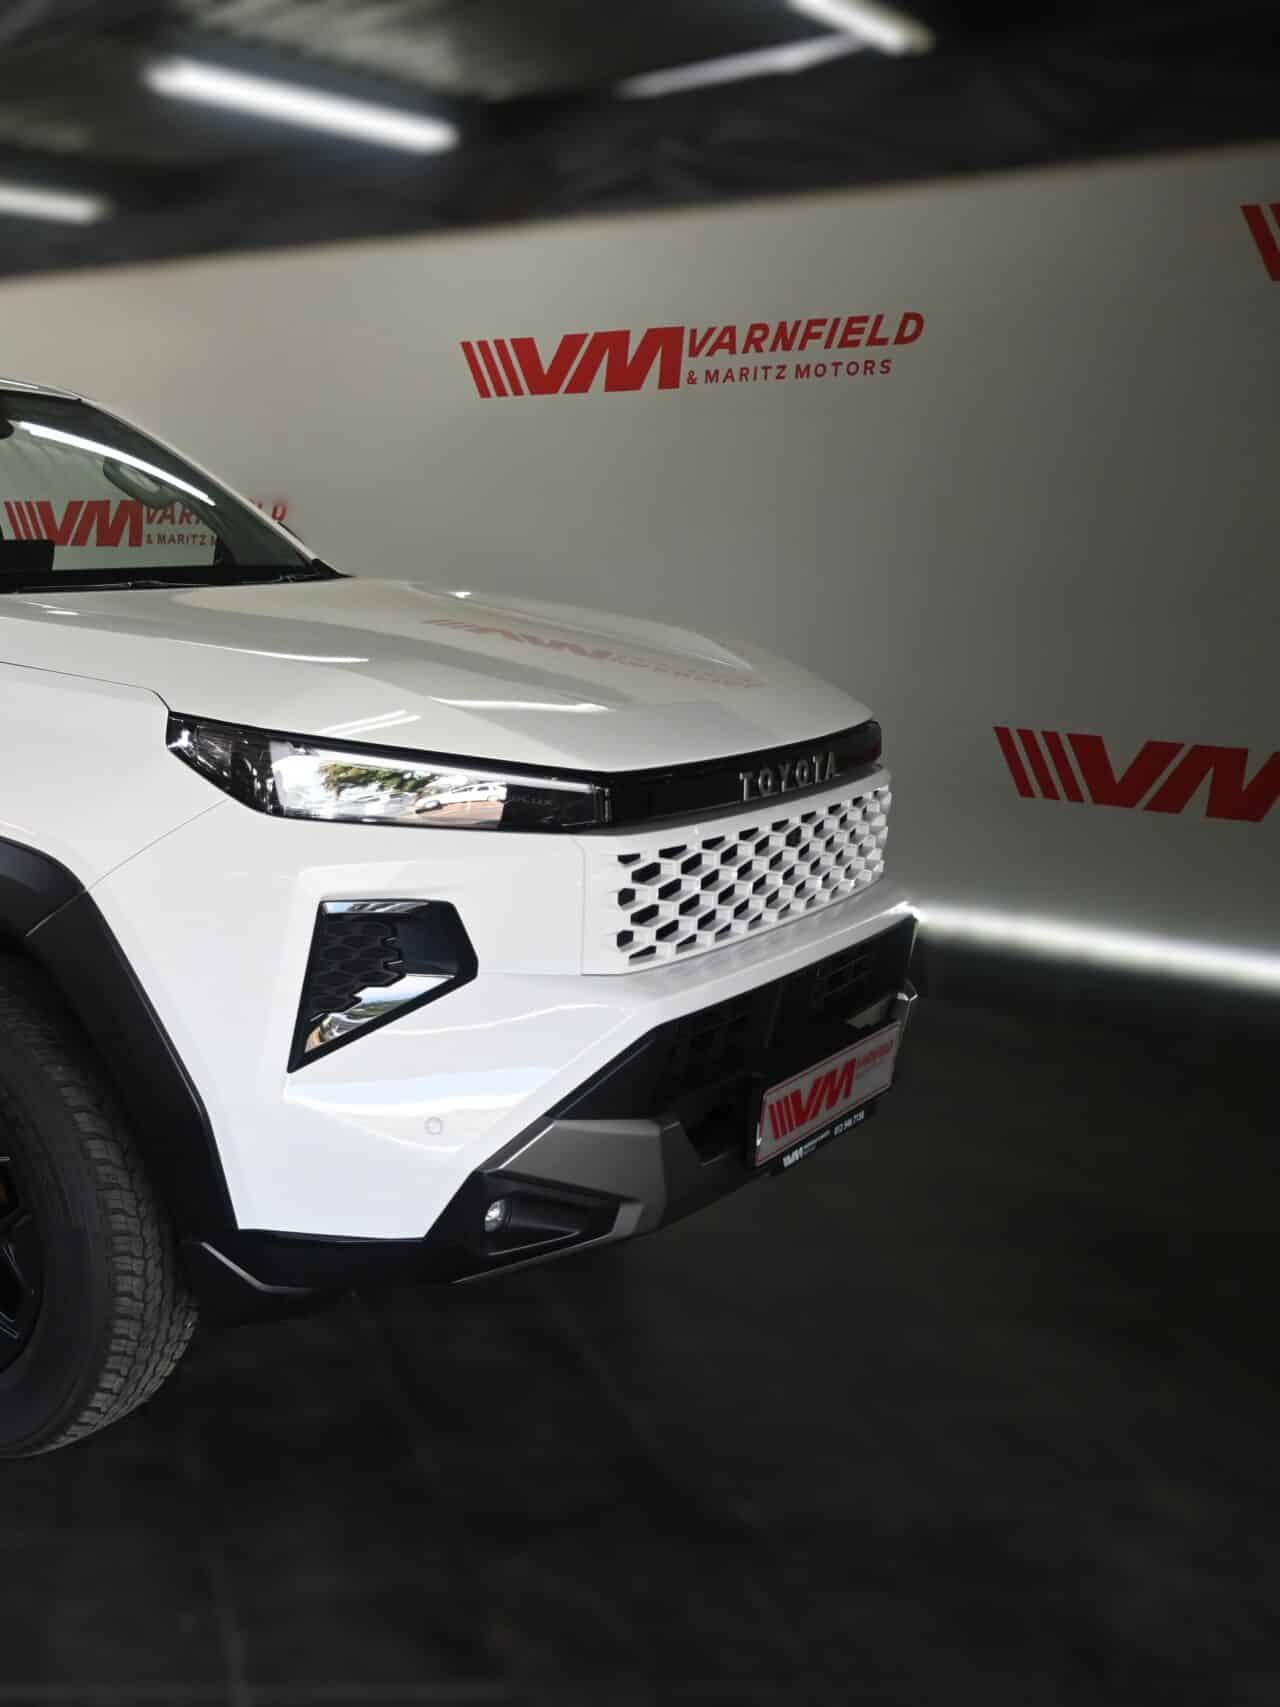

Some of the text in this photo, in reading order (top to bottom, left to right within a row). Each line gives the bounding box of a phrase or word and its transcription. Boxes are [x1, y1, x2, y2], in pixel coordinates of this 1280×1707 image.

[510, 311, 925, 396] VM VARNFIELD
[686, 359, 893, 385] & MARITZ MOTORS
[31, 500, 143, 547] VM
[157, 533, 207, 545] MARITZ
[739, 752, 838, 801] TOYOTA
[788, 1058, 857, 1127] VM
